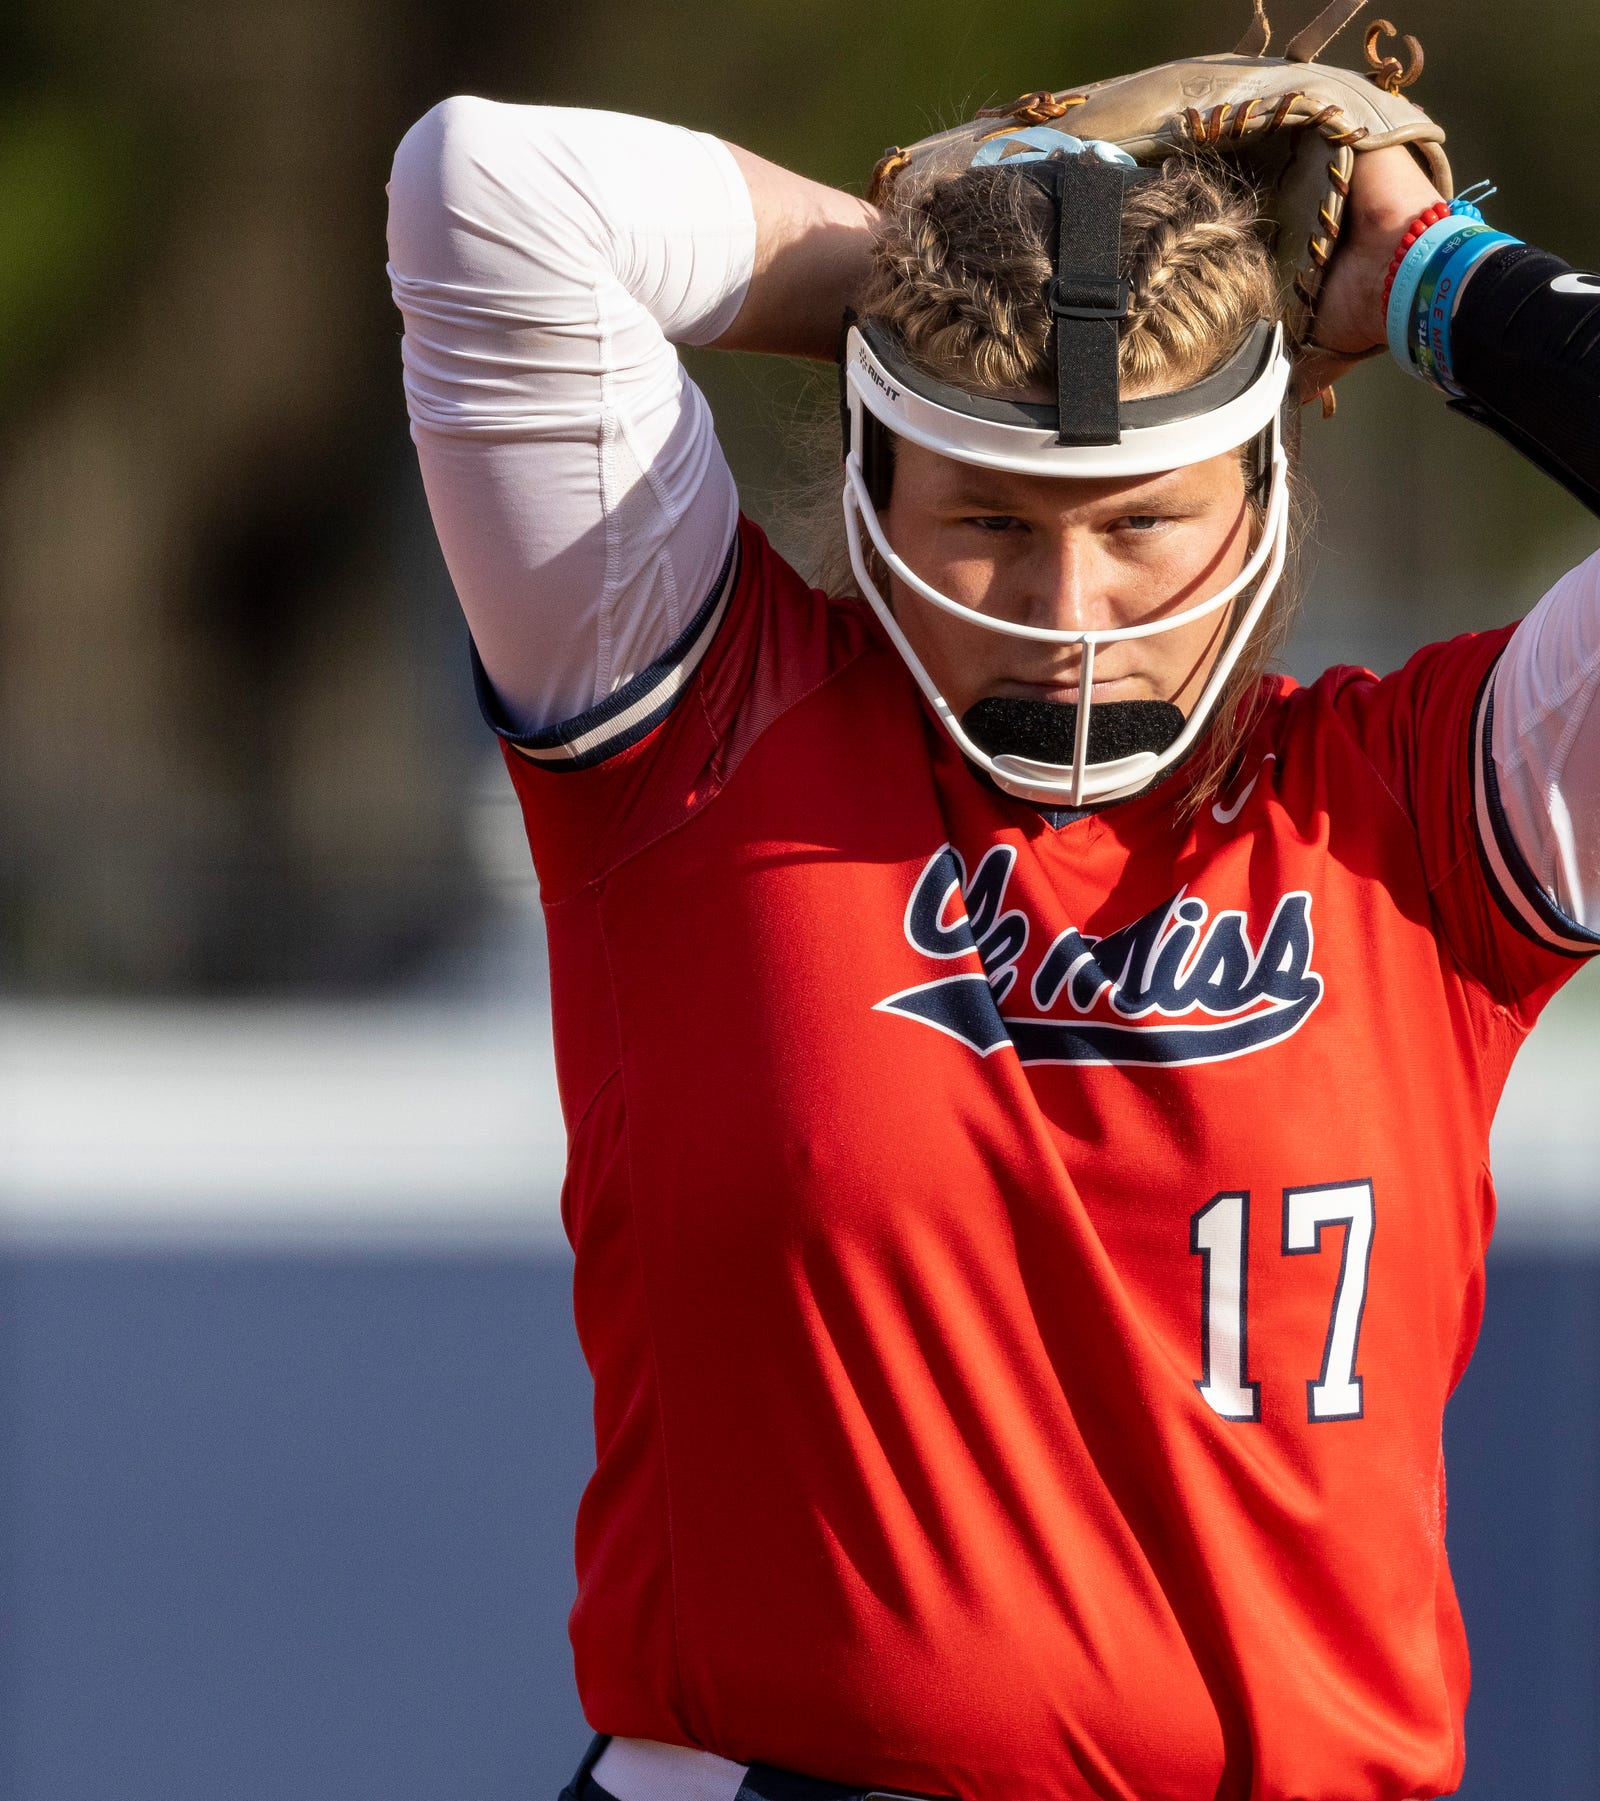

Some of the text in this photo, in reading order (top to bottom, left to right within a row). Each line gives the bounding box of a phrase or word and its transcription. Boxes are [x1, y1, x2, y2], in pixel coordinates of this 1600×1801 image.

[867, 364, 900, 401] RIP-IT
[1432, 277, 1451, 374] OLE MISS
[1031, 884, 1323, 1020] Miss
[1189, 1177, 1376, 1424] 17
